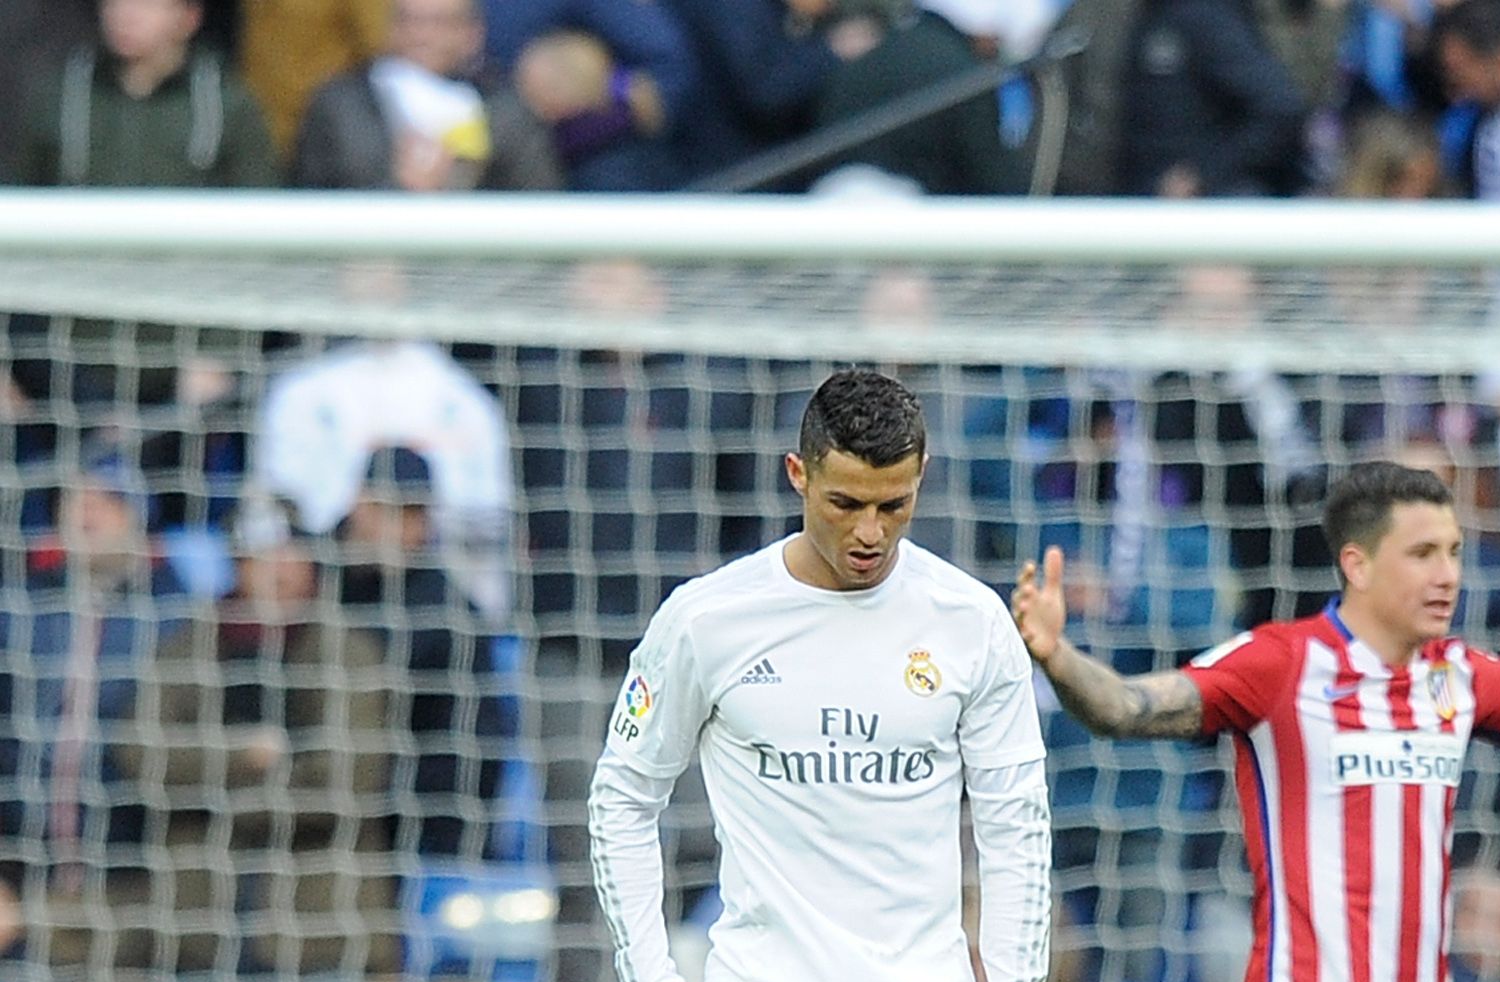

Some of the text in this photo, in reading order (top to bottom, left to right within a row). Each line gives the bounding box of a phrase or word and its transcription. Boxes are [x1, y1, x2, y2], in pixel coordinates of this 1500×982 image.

[741, 674, 782, 684] adidas
[614, 711, 639, 742] LFP
[820, 708, 879, 743] Fly
[751, 740, 937, 784] Emirates
